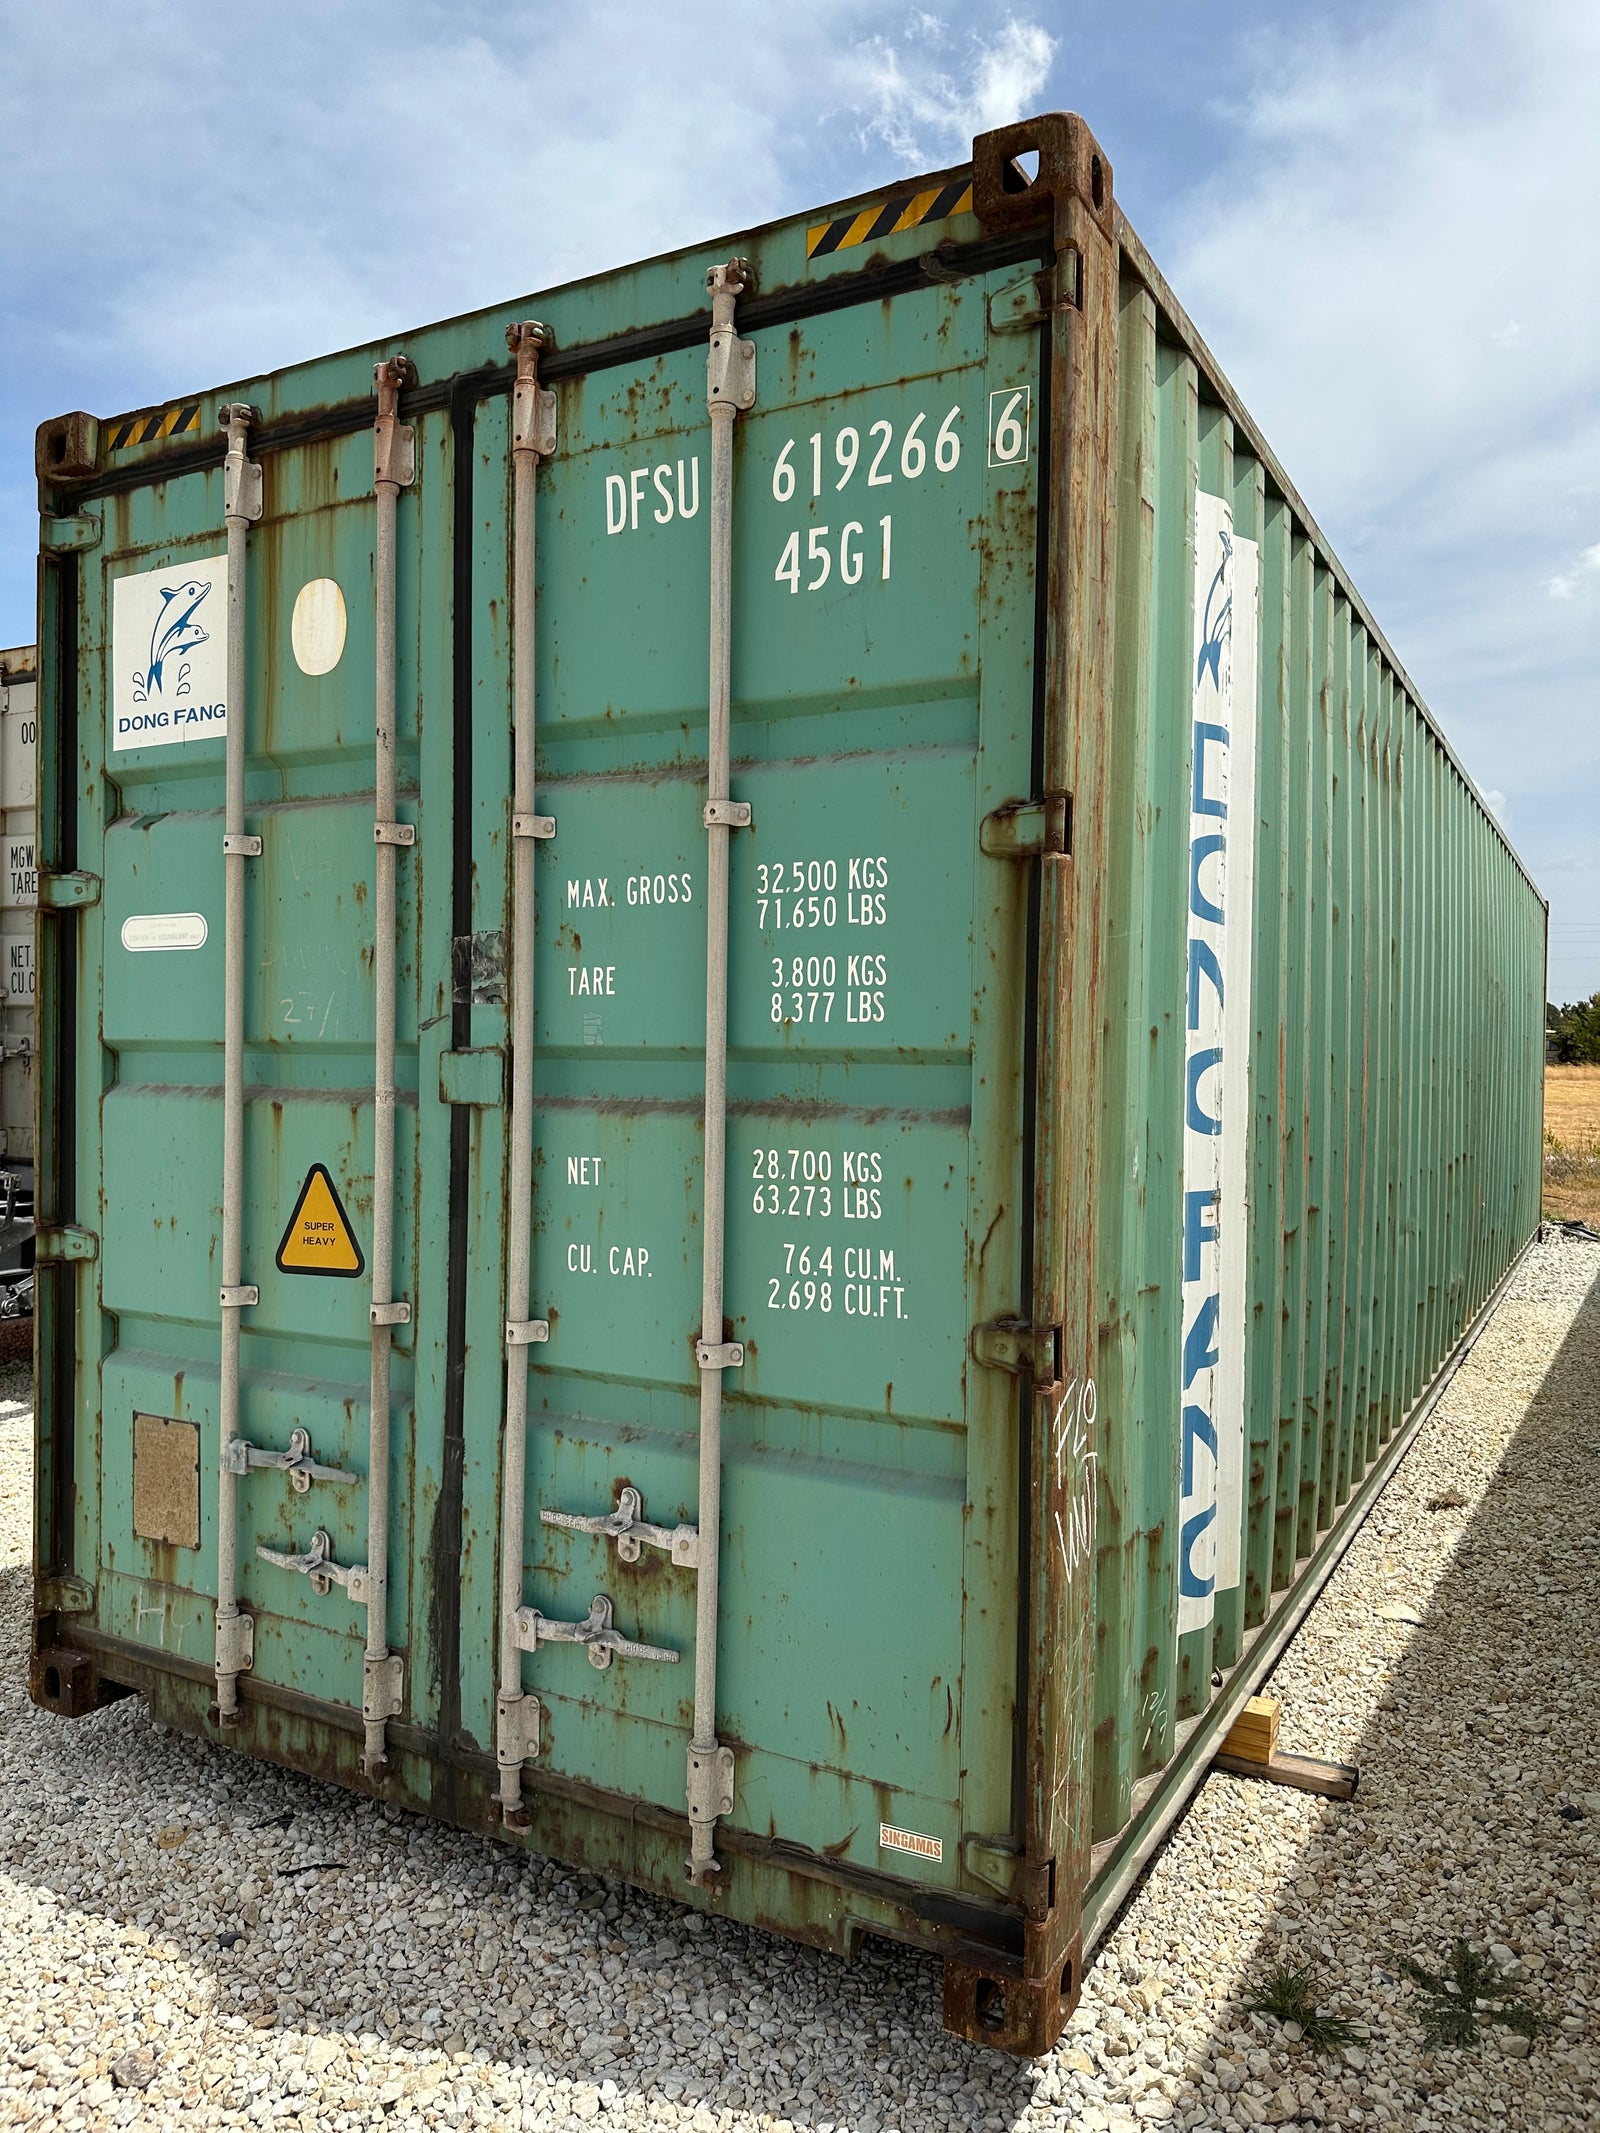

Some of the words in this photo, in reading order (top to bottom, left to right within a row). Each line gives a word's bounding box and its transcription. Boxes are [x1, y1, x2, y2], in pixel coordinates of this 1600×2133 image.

[606, 457, 699, 535] DFSU
[772, 405, 961, 502] 619266
[995, 391, 1023, 461] 6
[774, 515, 892, 594] 45G1
[119, 712, 169, 733] DONG
[174, 703, 226, 725] FANG
[11, 845, 34, 869] MGW
[11, 871, 37, 895] TARE
[567, 878, 616, 908] MAX.
[626, 873, 693, 906] GROSS
[756, 860, 837, 895] 32,500
[848, 857, 888, 890] KGS
[756, 896, 837, 930] 71,650
[847, 893, 888, 926] LBS
[568, 966, 616, 996] TARE
[771, 956, 836, 988] 3,800
[847, 955, 887, 986] KGS
[846, 991, 886, 1023] LBS
[568, 1157, 602, 1186] NET
[752, 1149, 832, 1182] 28,700
[843, 1151, 883, 1183] KGS
[752, 1184, 832, 1217] 63,273
[844, 1188, 882, 1220] LBS
[303, 1236, 336, 1246] HEAVY
[304, 1222, 334, 1231] SUPER
[567, 1244, 597, 1273] CU.
[609, 1247, 652, 1277] CAP.
[783, 1244, 833, 1277] 76.4
[844, 1248, 901, 1282] CU.M.
[768, 1278, 832, 1312] 2,698
[844, 1284, 909, 1319] CU.FT.
[881, 1827, 941, 1857] SINGAMAS
